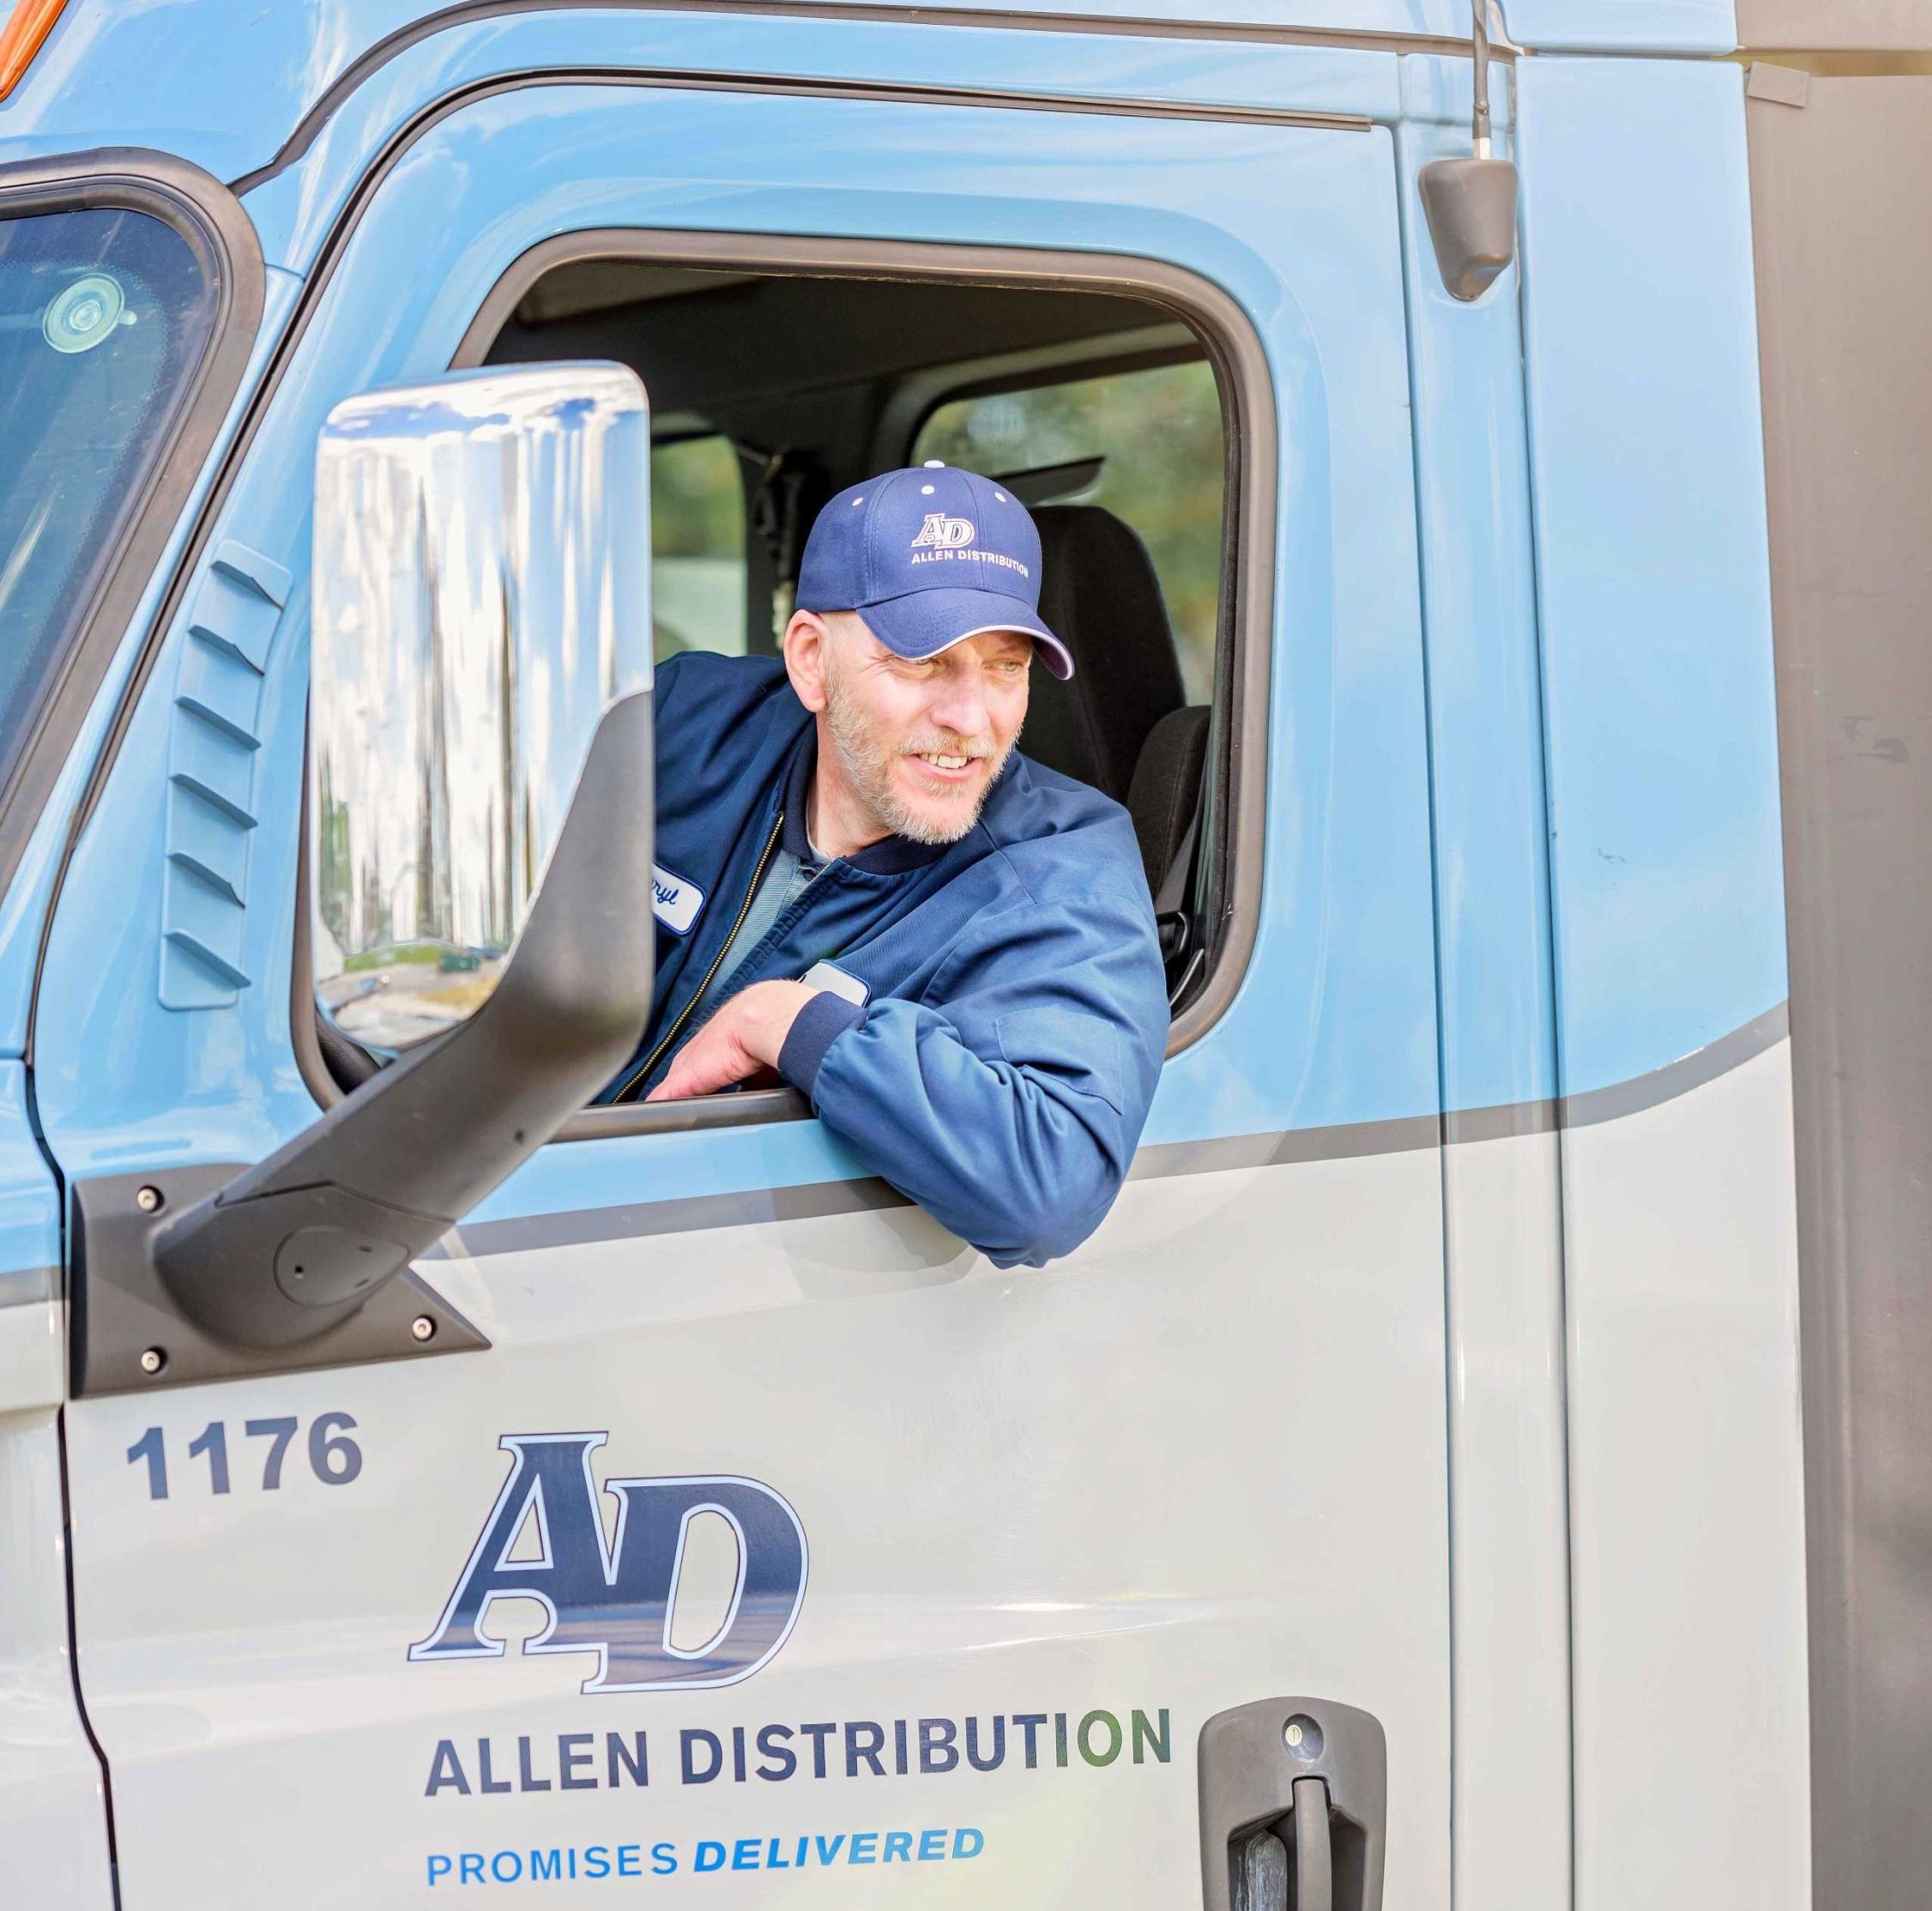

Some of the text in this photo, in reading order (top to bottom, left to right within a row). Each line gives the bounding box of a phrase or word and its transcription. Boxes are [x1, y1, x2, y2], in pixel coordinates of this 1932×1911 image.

[912, 514, 975, 549] AD
[912, 549, 1029, 578] ALLEN DISTRIBUTION
[127, 1412, 363, 1501] 1176
[407, 1430, 809, 1695] AD
[424, 1708, 1171, 1797] ALLEN DISTRIBUTION
[426, 1828, 985, 1887] PROMISES DELIVERED
